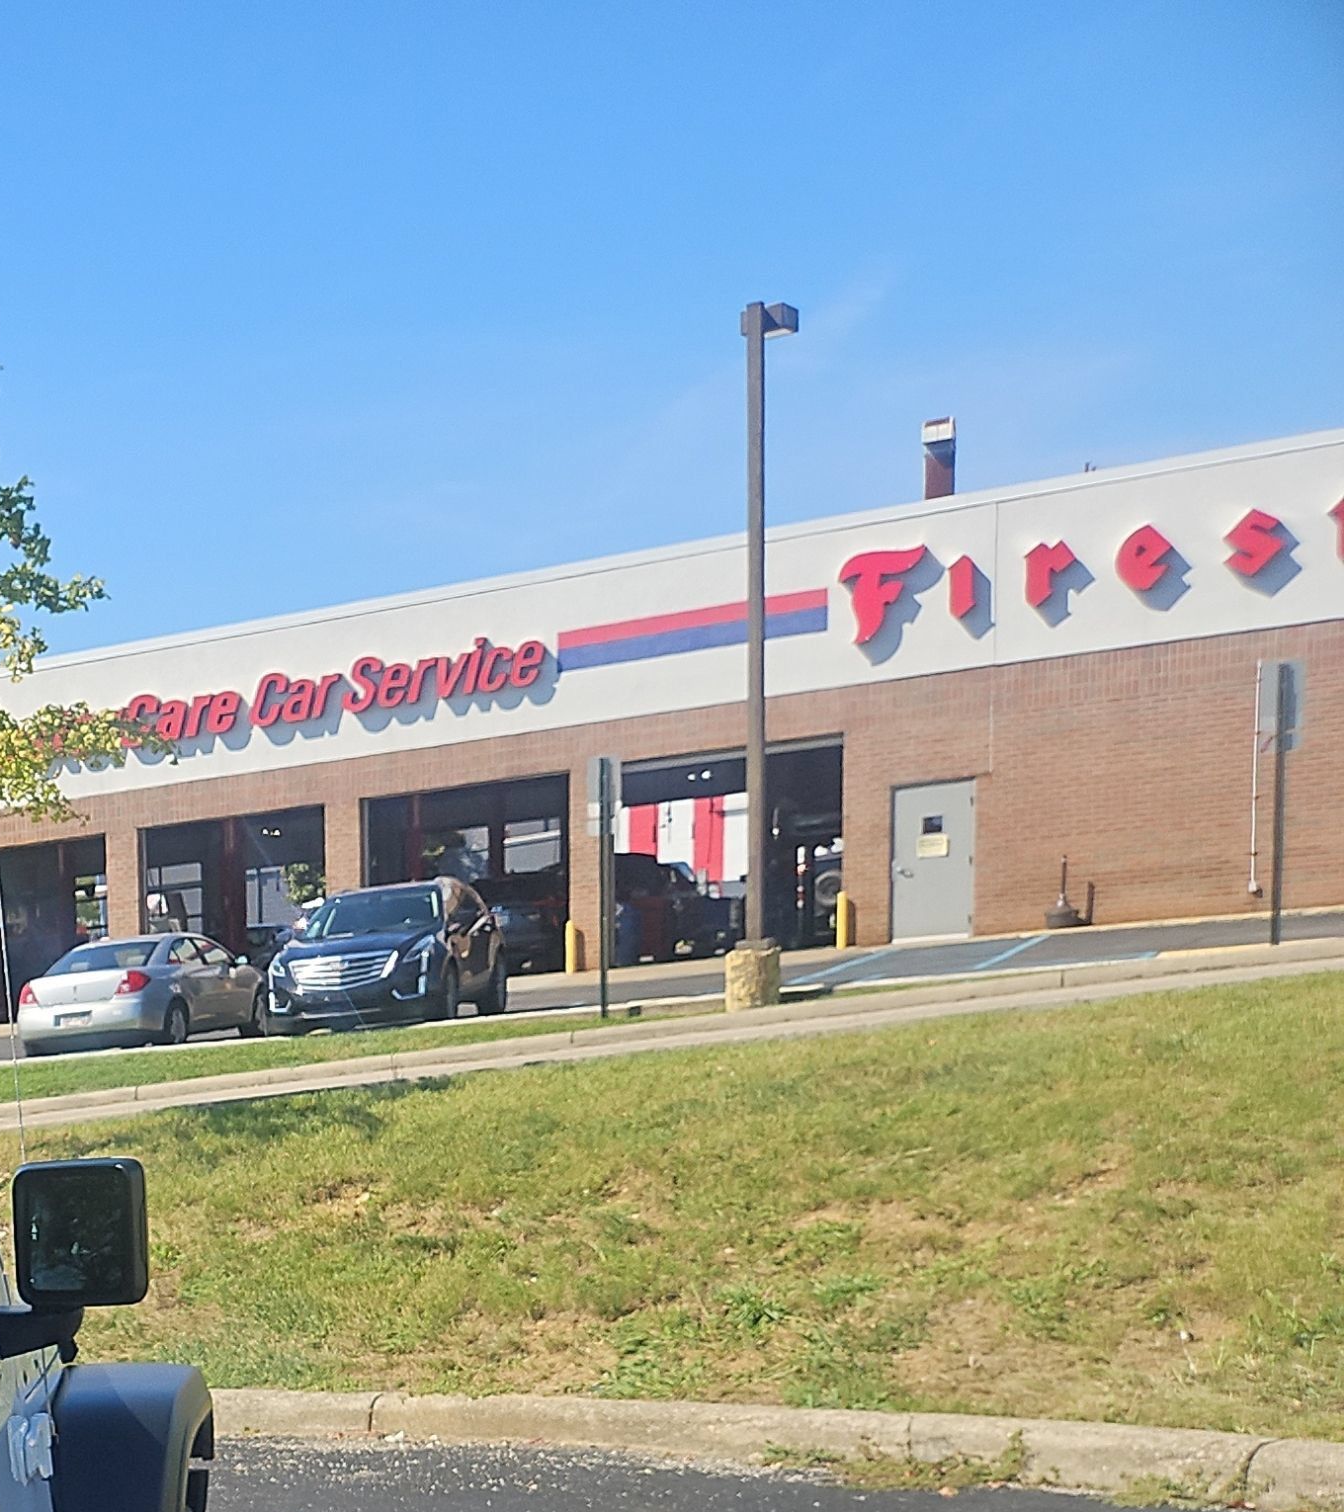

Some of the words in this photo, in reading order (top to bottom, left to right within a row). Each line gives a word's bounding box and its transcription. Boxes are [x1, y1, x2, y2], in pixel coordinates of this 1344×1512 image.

[838, 496, 1344, 645] Fires
[249, 672, 343, 727] Car
[341, 637, 544, 713] Service
